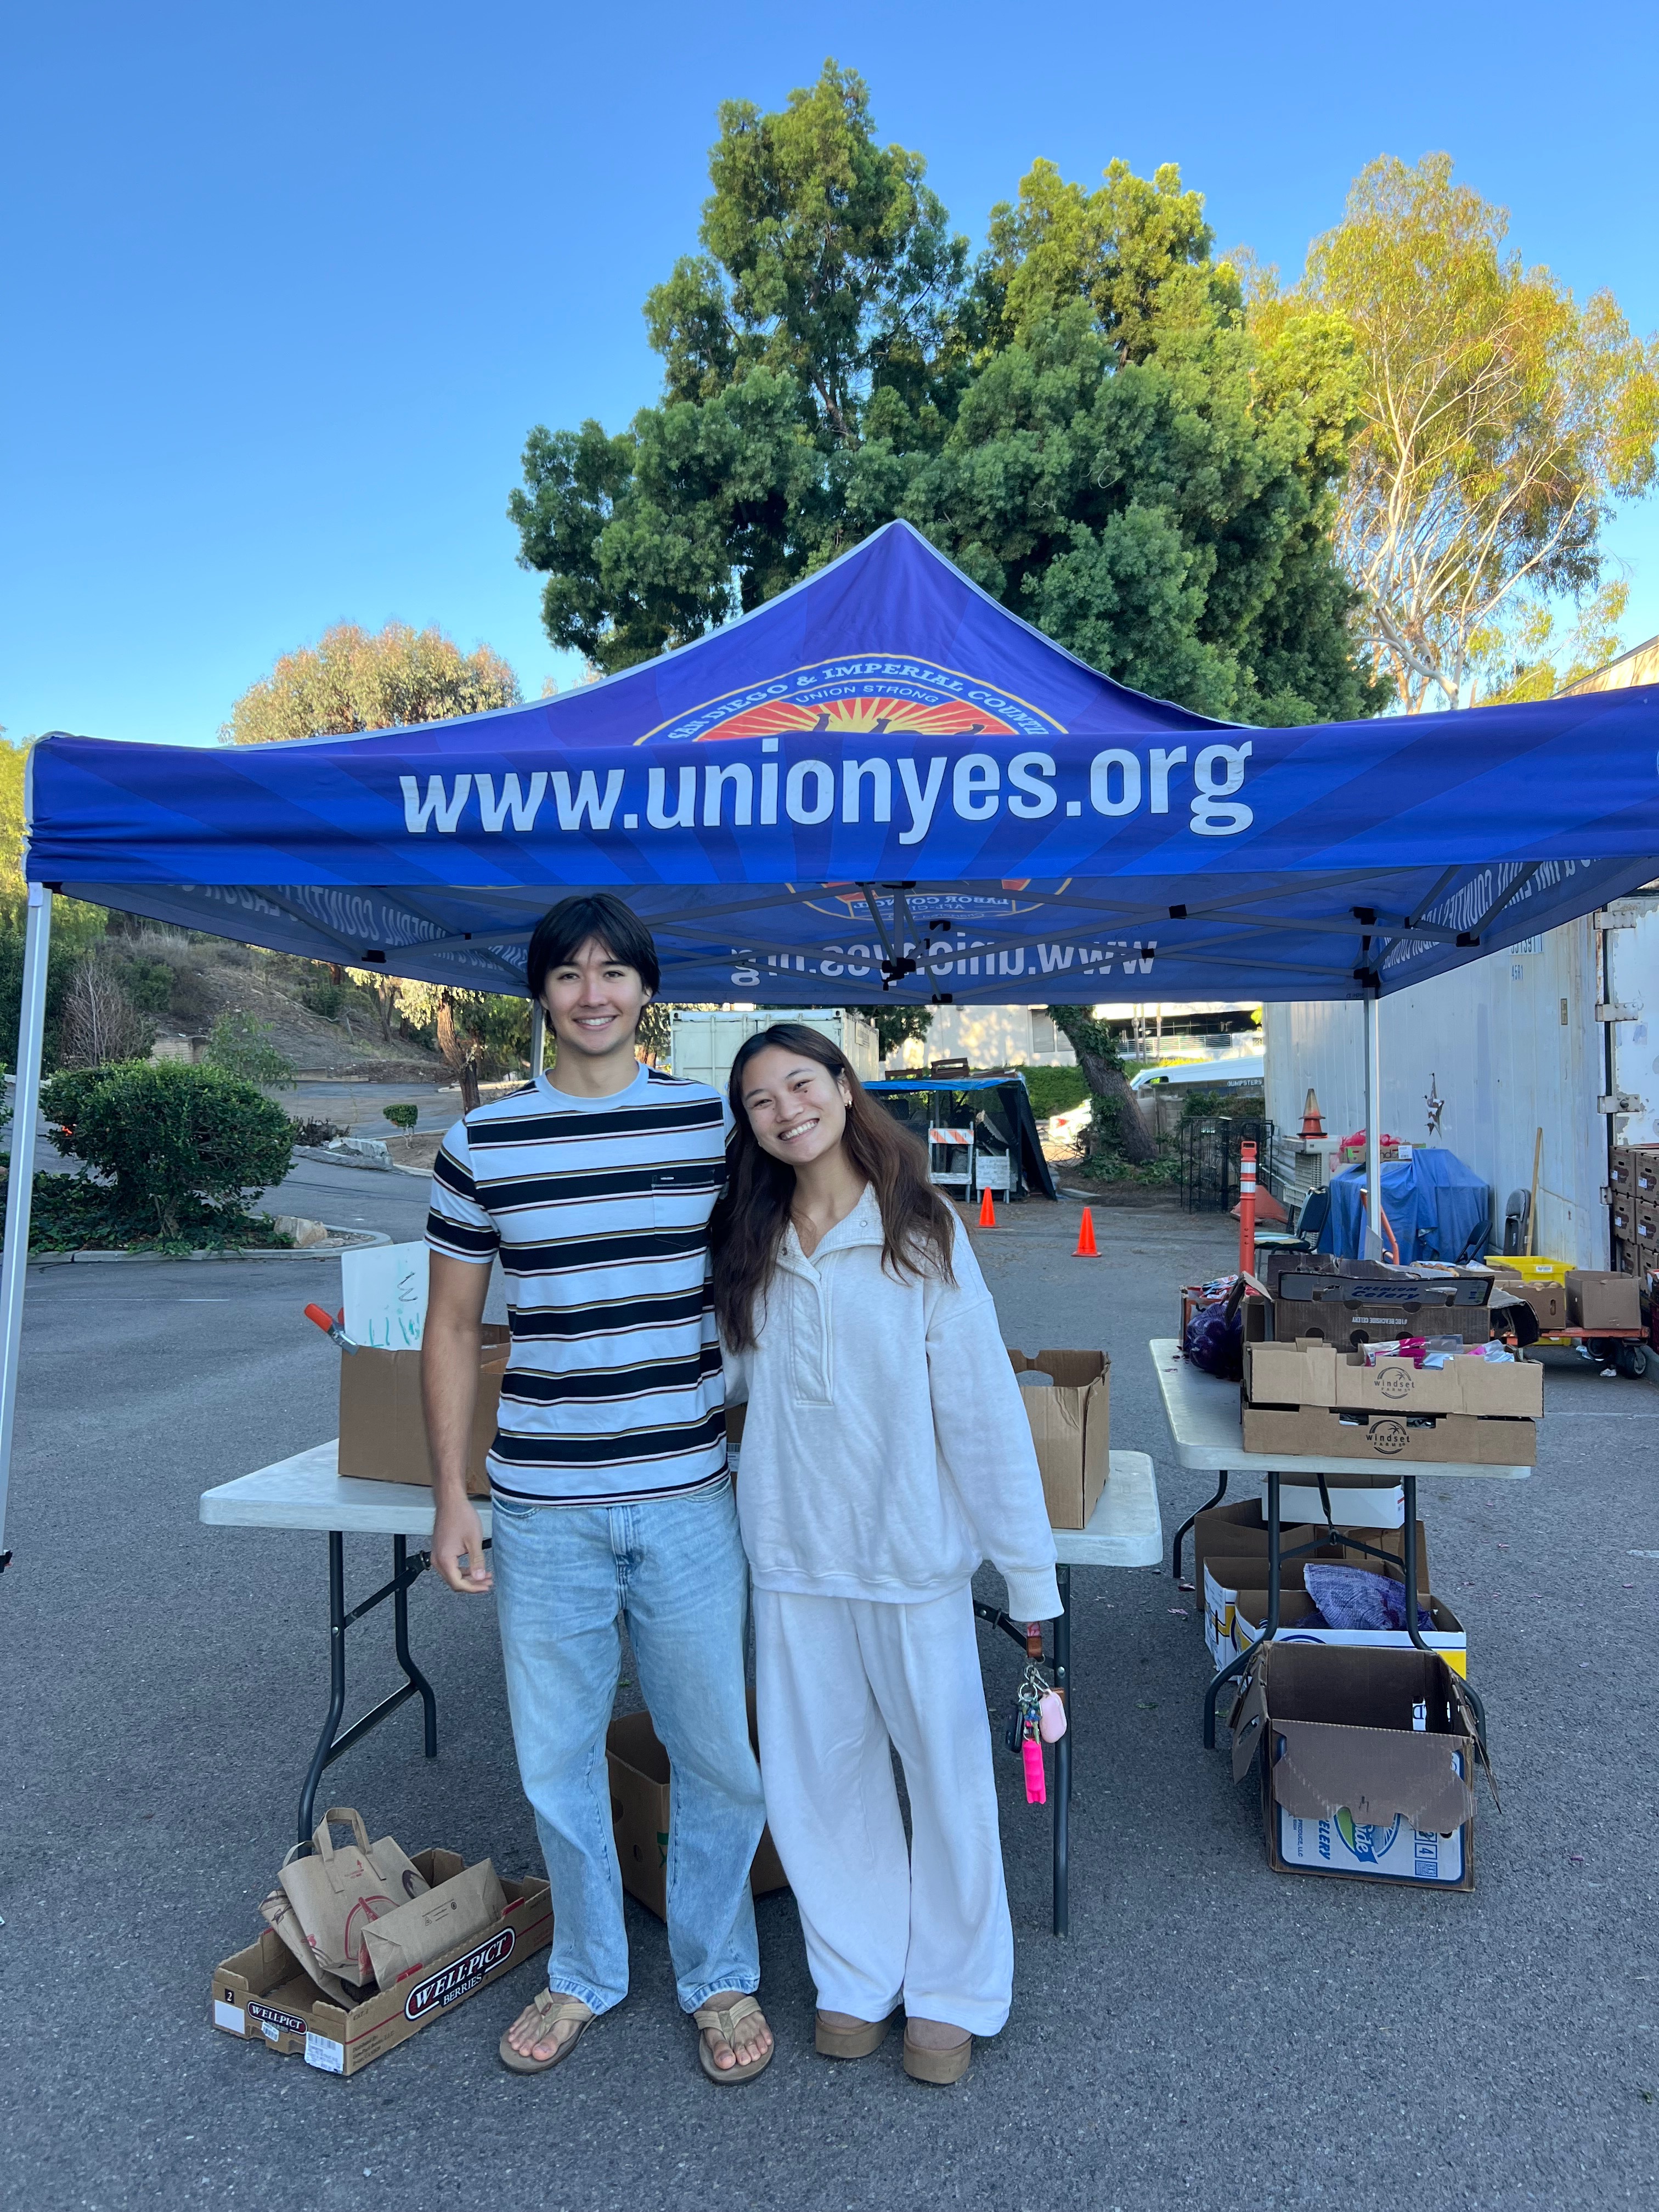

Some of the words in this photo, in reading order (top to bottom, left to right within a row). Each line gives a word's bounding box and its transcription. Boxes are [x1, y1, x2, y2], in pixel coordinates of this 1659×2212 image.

[667, 720, 709, 740] SAN
[702, 684, 788, 720] DIEGO
[796, 675, 817, 686] &
[822, 663, 964, 692] IMPERIAL
[795, 686, 856, 703] UNION
[863, 685, 939, 703] STRONG
[399, 738, 1254, 845] www.unionyes.org
[1511, 964, 1523, 980] 45R1
[1352, 1290, 1420, 1300] Celery
[1374, 1380, 1415, 1389] windset
[1366, 1434, 1410, 1443] windset
[1319, 1820, 1330, 1860] ELERY
[443, 1973, 482, 2006] BERRIES
